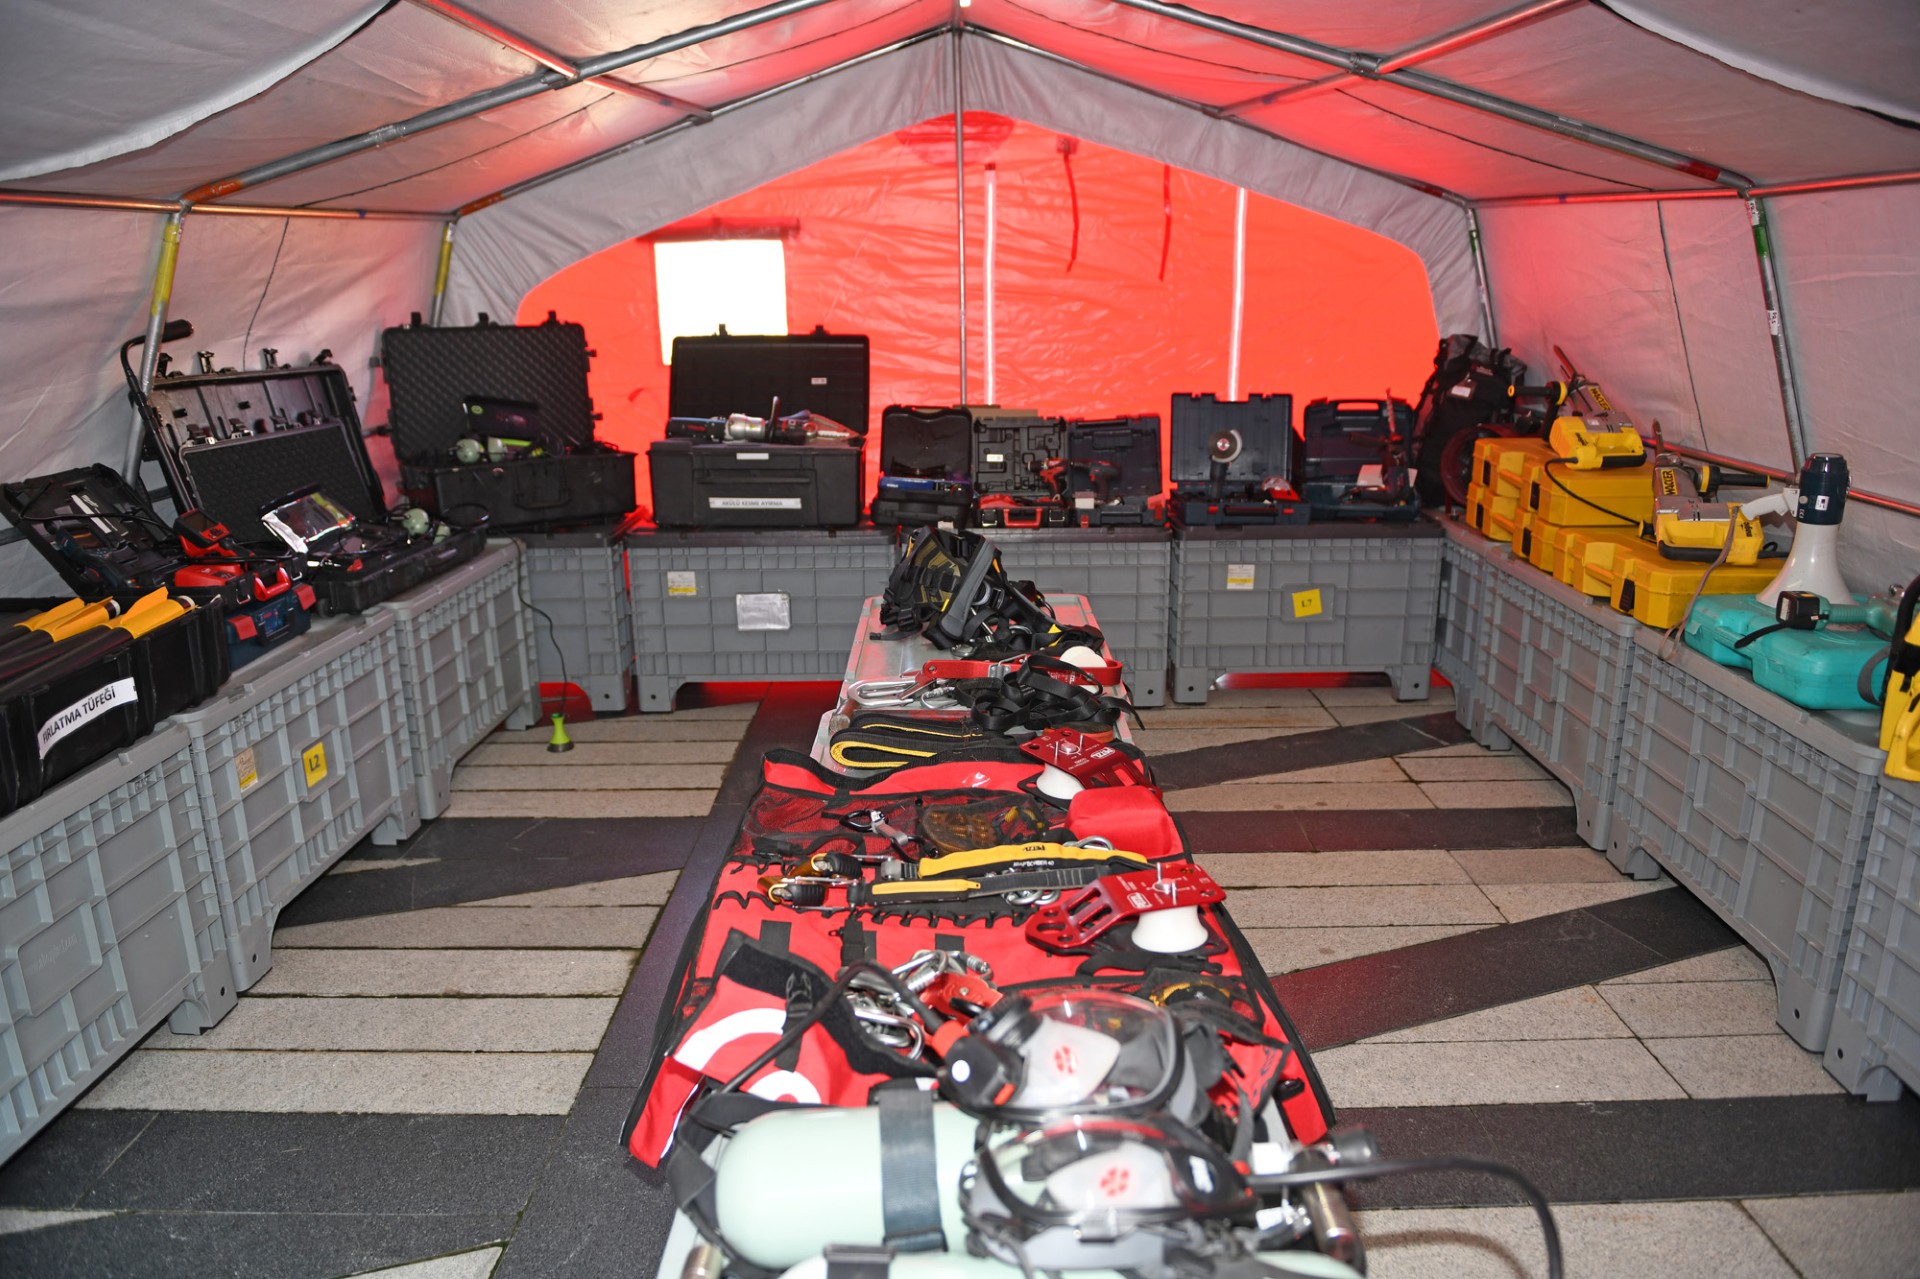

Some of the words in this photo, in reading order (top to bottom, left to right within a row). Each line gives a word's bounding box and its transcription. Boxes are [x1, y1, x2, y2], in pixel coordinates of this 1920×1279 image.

[42, 708, 82, 744] FIRLATMA
[82, 686, 116, 715] TÜFEĞİ
[309, 753, 320, 772] L2
